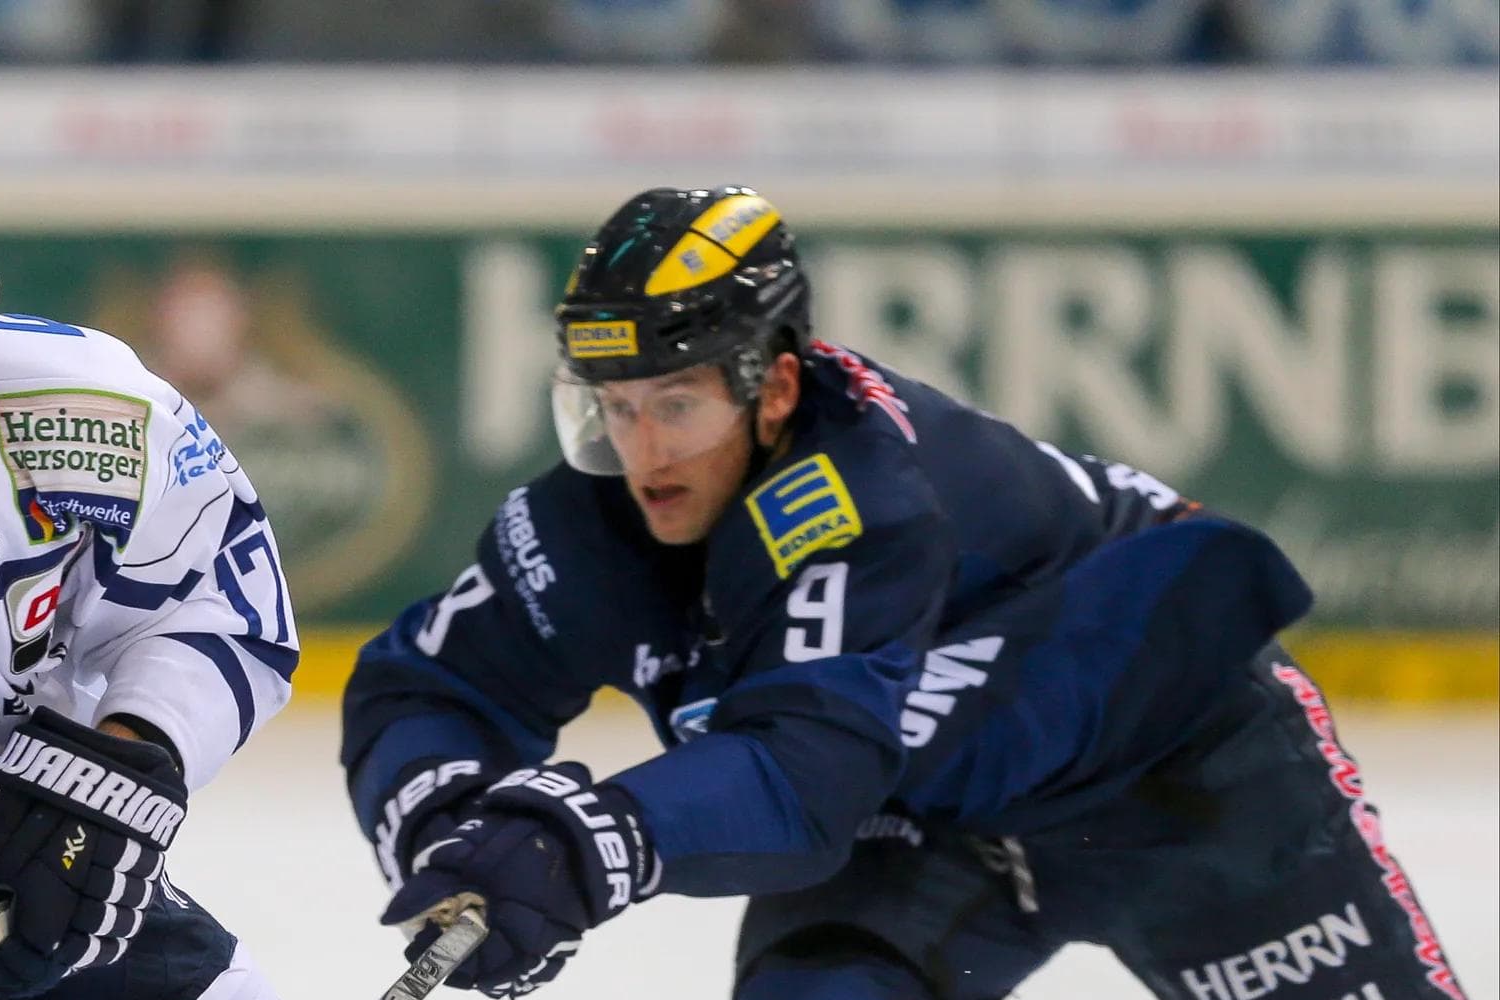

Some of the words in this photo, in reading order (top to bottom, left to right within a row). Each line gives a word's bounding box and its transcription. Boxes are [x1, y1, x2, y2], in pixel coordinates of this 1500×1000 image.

[1, 407, 142, 452] Heimat
[9, 446, 142, 483] versorger
[214, 530, 289, 643] 17
[783, 561, 849, 663] 9
